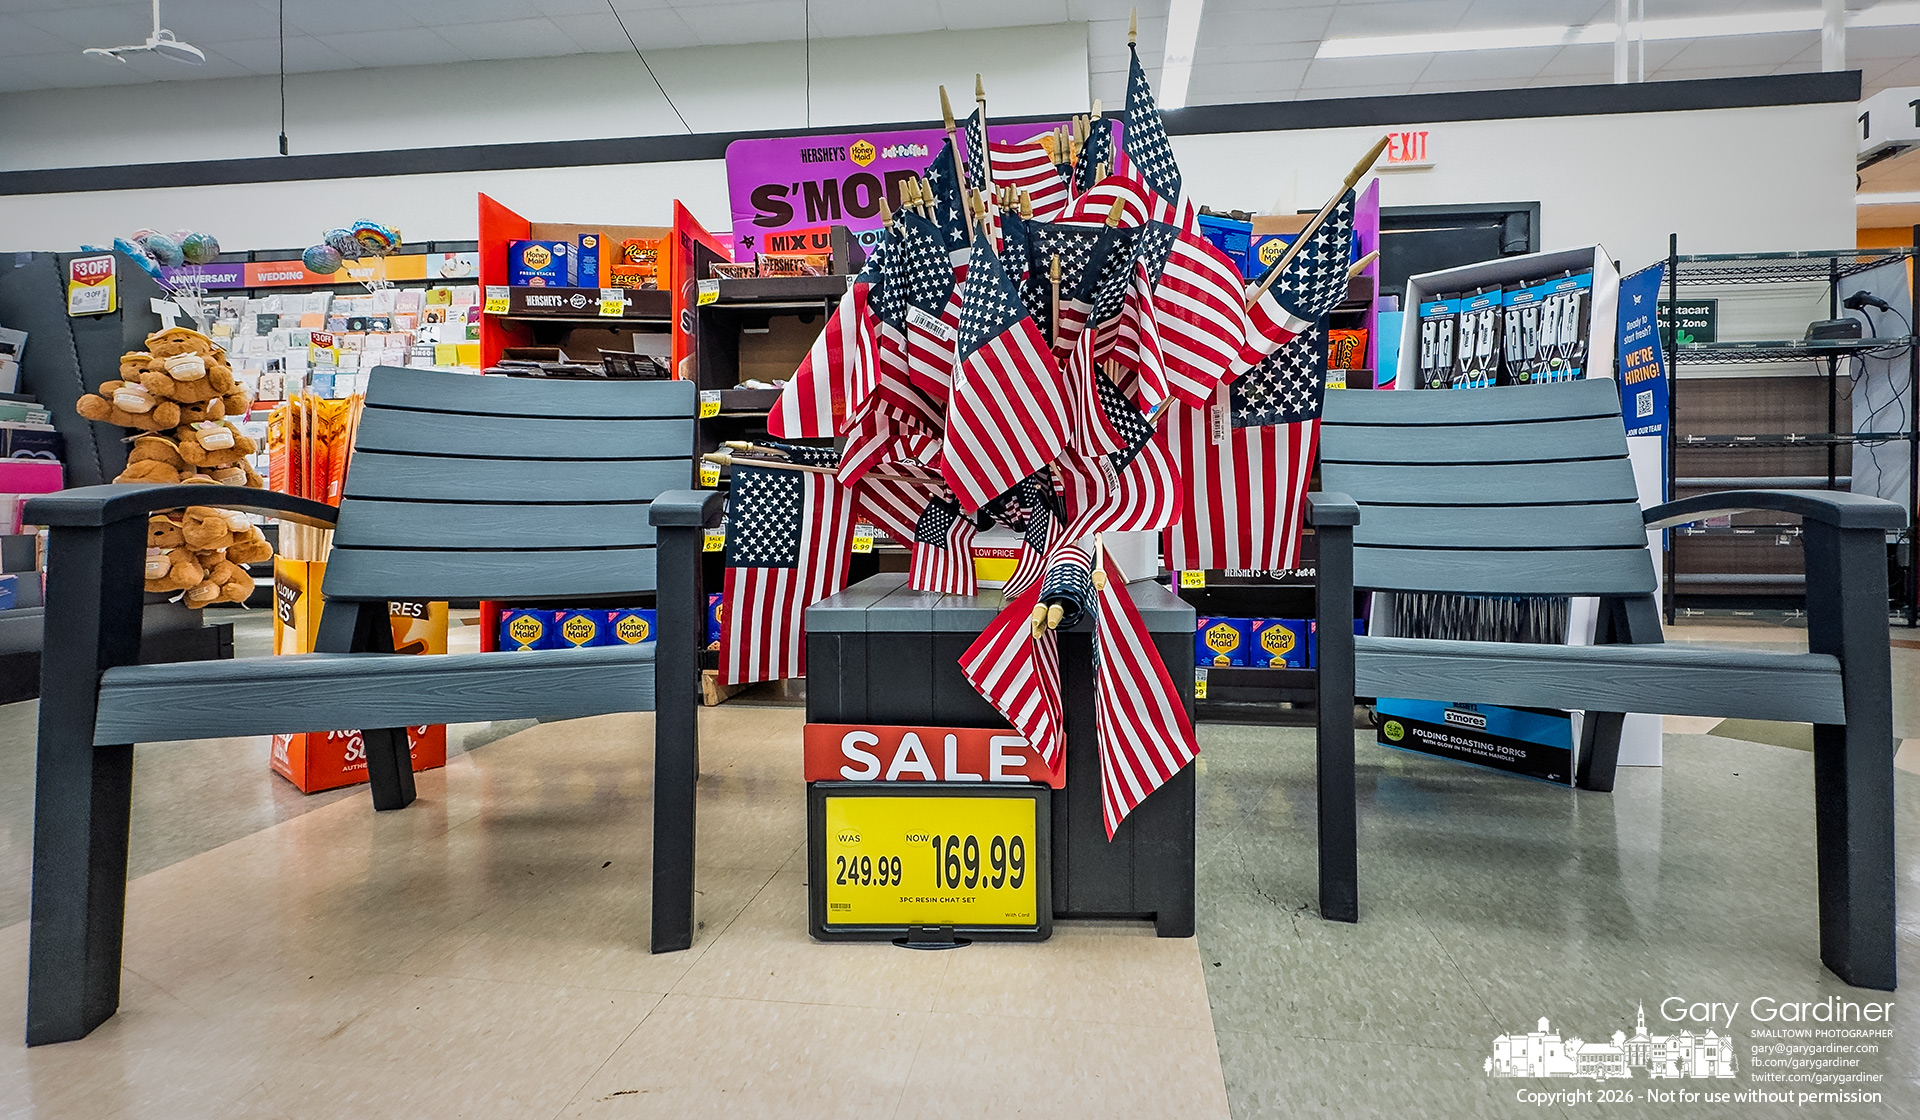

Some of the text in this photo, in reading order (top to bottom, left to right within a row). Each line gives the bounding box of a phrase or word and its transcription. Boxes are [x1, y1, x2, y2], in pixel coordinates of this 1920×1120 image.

[1858, 111, 1870, 140] 1
[852, 147, 874, 156] Honey
[881, 144, 929, 159] Jet-Puffed
[1387, 131, 1428, 162] EXIT
[801, 146, 846, 164] HERSHEY'S
[853, 154, 871, 162] Maid
[771, 235, 806, 252] MIX
[812, 233, 831, 250] U
[526, 251, 549, 259] Honey
[625, 244, 658, 257] Reese
[1262, 247, 1285, 255] Hone
[75, 260, 109, 276] $3 OFF
[348, 268, 376, 277] BABY
[169, 273, 238, 285] ANNIVERSARY
[257, 271, 303, 282] WEDDING
[610, 273, 640, 283] eese's
[526, 295, 562, 307] HERSHEY'S
[1626, 315, 1648, 332] Ready to
[1683, 319, 1708, 328] Zone
[320, 335, 332, 343] OFF
[1623, 325, 1652, 345] start fresh?
[1625, 346, 1654, 368] WE'RE
[1624, 362, 1660, 386] HIRING!
[703, 408, 717, 416] 1.99
[1626, 424, 1662, 437] JOIN OUR TEAM
[975, 548, 1015, 558] LOW PRICE
[1184, 578, 1201, 586] 1.99
[512, 622, 540, 634] Honey
[514, 629, 534, 639] Maid
[565, 622, 593, 634] Honey
[567, 629, 587, 639] Maid
[619, 622, 647, 634] Honey
[621, 629, 641, 639] Maid
[1208, 630, 1237, 642] Honey
[1264, 632, 1293, 644] Honey
[1210, 638, 1232, 648] Maid
[1266, 641, 1288, 650] Maid
[1446, 712, 1485, 726] s'mores
[1412, 728, 1527, 758] FOLDING ROASTING FORKS
[840, 730, 1030, 782] SALE
[1422, 738, 1436, 746] WITH
[1437, 741, 1454, 750] GLOW
[1461, 745, 1472, 753] THE
[1472, 748, 1488, 757] DARK
[1488, 751, 1515, 762] HANDLES
[838, 834, 861, 843] WAS
[905, 834, 929, 842] NOW
[932, 835, 1025, 889] 169.99
[836, 855, 902, 886] 249.99
